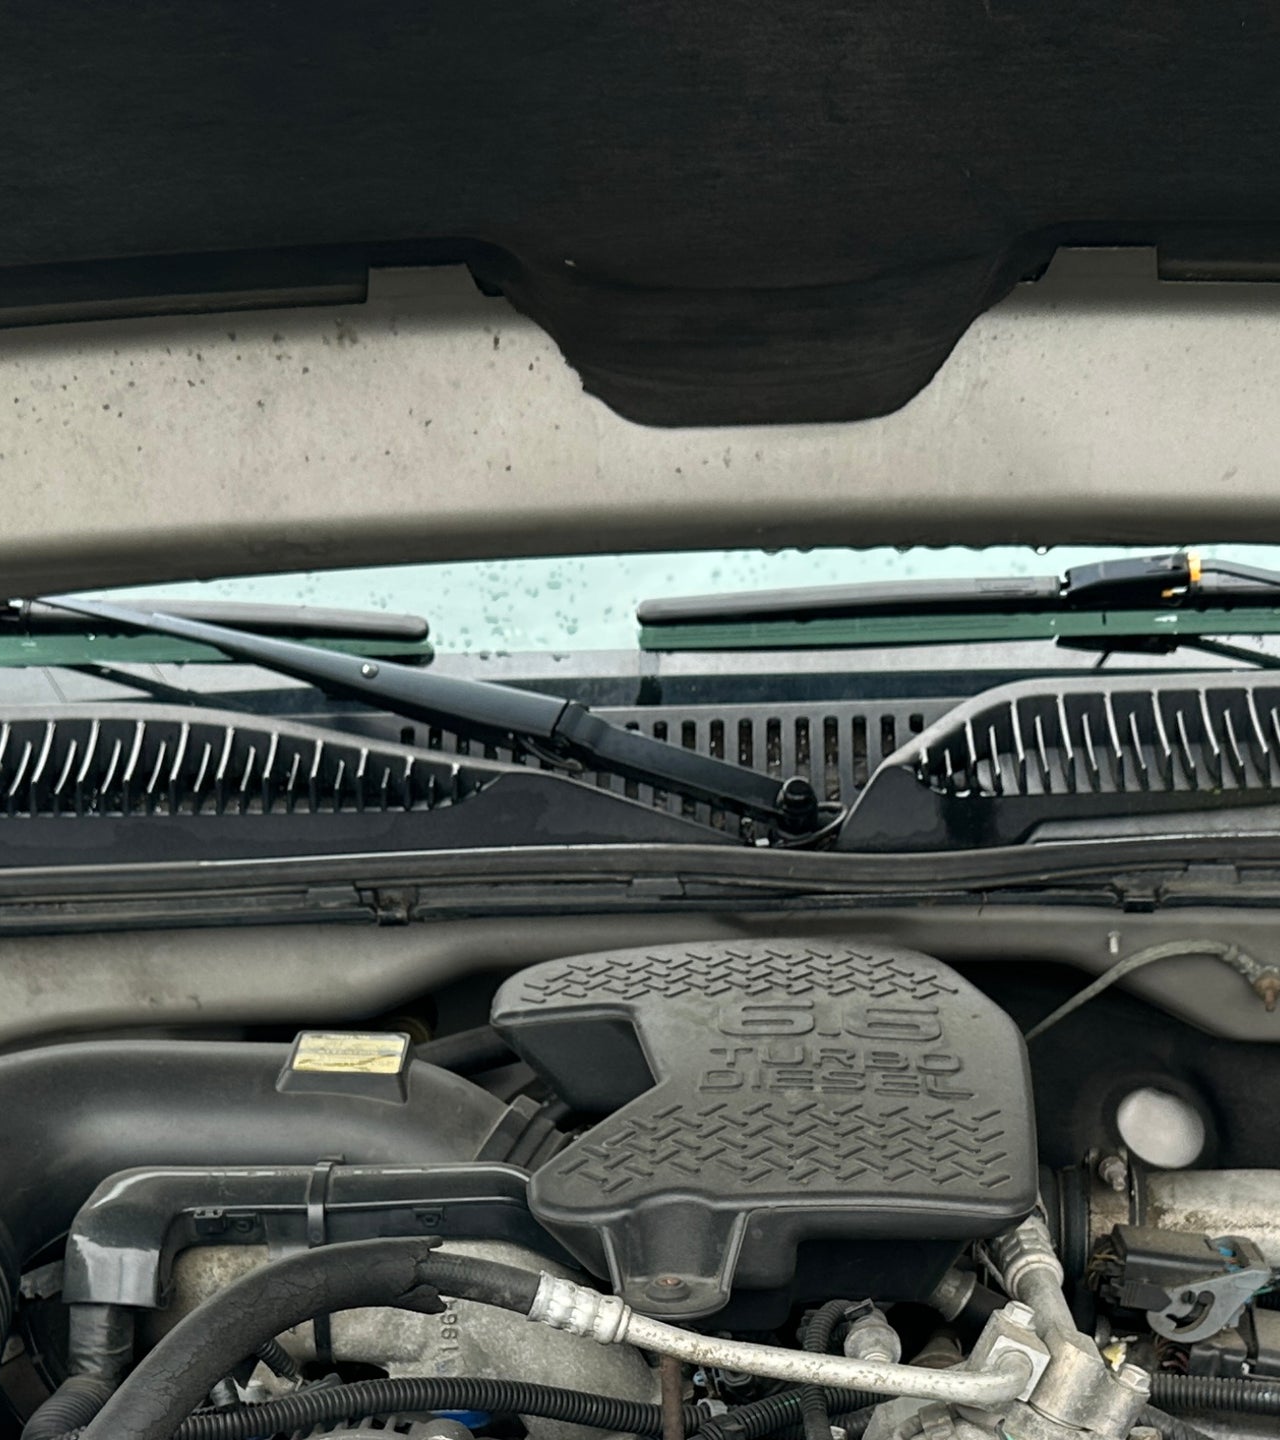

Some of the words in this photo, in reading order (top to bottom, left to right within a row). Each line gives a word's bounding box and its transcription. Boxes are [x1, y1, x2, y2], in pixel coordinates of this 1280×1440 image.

[717, 1000, 942, 1042] 6.6
[710, 1047, 961, 1075] TURBO
[699, 1069, 975, 1100] DIESEL
